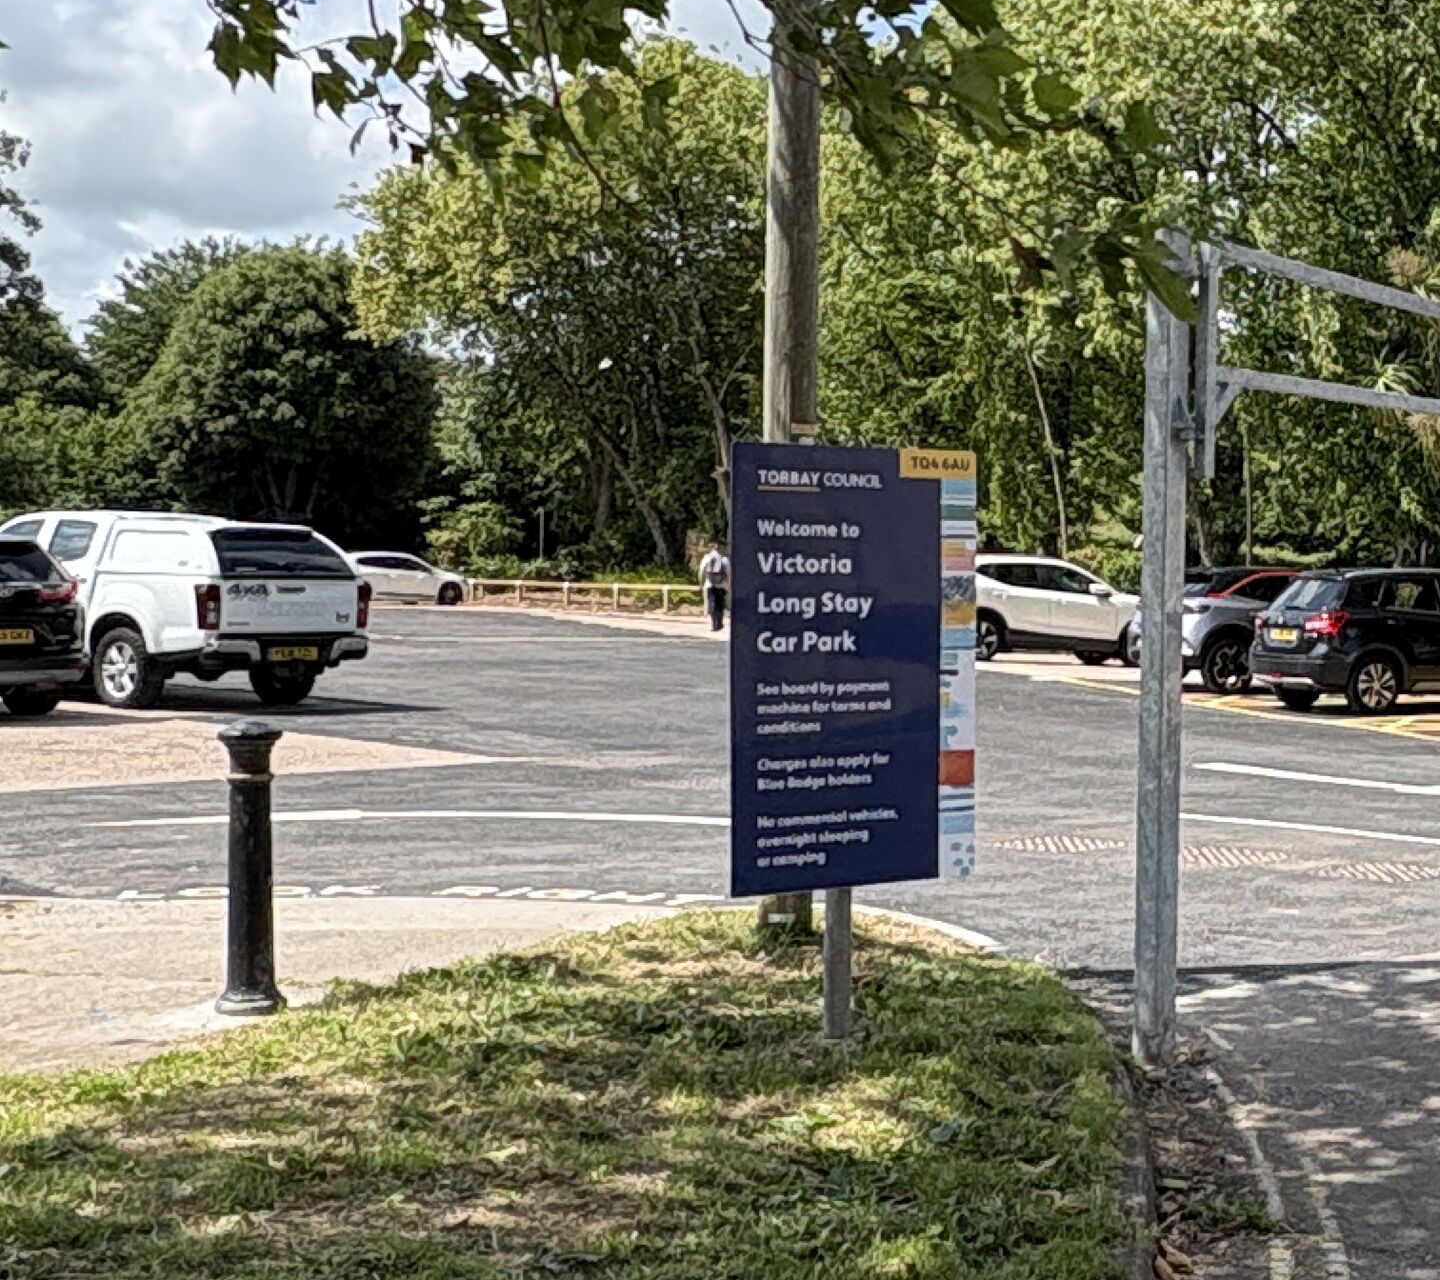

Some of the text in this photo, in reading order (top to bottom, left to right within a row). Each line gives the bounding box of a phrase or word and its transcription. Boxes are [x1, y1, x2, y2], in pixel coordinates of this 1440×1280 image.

[911, 455, 939, 471] TQ4
[757, 470, 883, 489] TORBAY COUNCIL
[757, 520, 860, 538] Welcome to
[757, 552, 852, 574] Victoria
[757, 591, 874, 619] Long Stay
[756, 629, 857, 653] Car Park
[757, 682, 779, 695] See
[820, 681, 835, 696] by
[811, 700, 830, 712] for
[867, 698, 891, 711] and
[757, 758, 807, 772] Charges
[809, 755, 835, 768] also
[836, 752, 870, 769] apply
